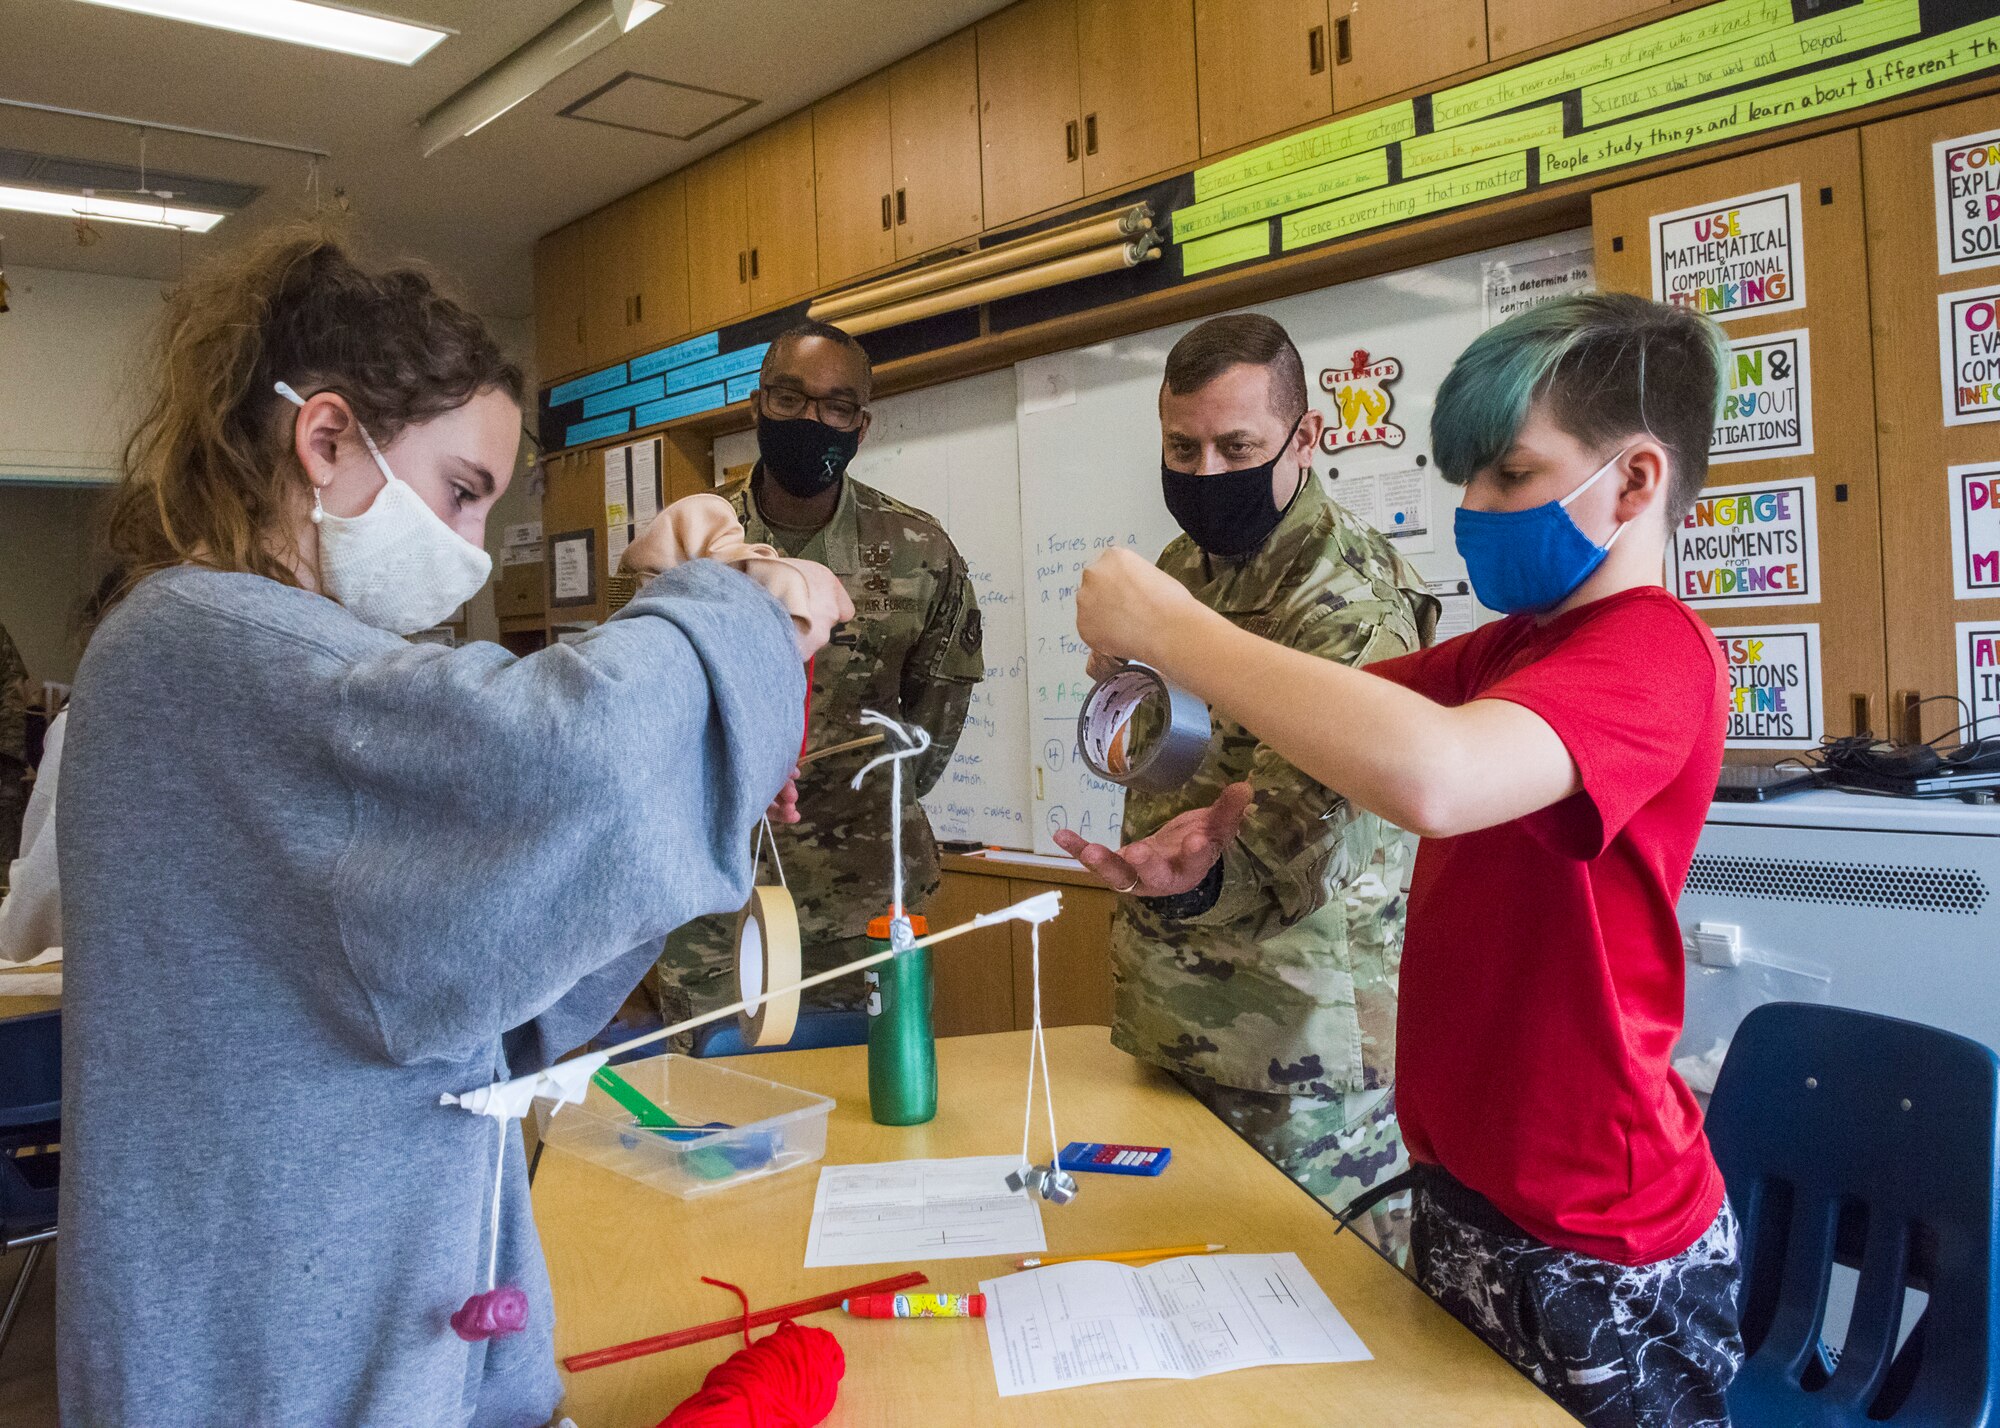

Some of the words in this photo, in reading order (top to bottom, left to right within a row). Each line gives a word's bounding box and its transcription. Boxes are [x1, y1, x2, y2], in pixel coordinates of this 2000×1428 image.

[1434, 99, 1479, 123] Science
[1486, 95, 1495, 106] is
[1499, 81, 1515, 102] the
[1521, 79, 1544, 95] never
[1637, 41, 1663, 62] people
[1669, 31, 1692, 51] who
[1591, 89, 1640, 114] Science
[1665, 74, 1688, 94] about
[1722, 60, 1744, 79] world
[1753, 48, 1777, 69] and
[1546, 150, 1589, 173] People
[1597, 135, 1643, 161] study
[1649, 127, 1704, 148] things
[1707, 105, 1738, 132] and
[1749, 100, 1795, 122] learn
[1801, 78, 1857, 107] about
[1865, 59, 1960, 90] different
[1281, 137, 1333, 168] BUNCH
[1292, 215, 1333, 241] Science
[1337, 215, 1346, 228] is
[1424, 178, 1454, 204] that
[1460, 182, 1471, 196] is
[1475, 168, 1525, 191] matter
[1965, 199, 1981, 219] &
[1694, 210, 1742, 242] USE
[1665, 227, 1787, 271] MATHEMATICAL
[1717, 256, 1726, 266] &
[1501, 285, 1516, 296] can
[1519, 273, 1569, 292] determine
[1571, 268, 1588, 280] the
[1672, 255, 1784, 292] COMPUTATIONAL
[1500, 297, 1533, 314] central
[1325, 363, 1395, 384] SCIENCE
[1767, 349, 1792, 381] &
[1758, 387, 1795, 415] OUT
[1329, 433, 1338, 446] I
[1048, 533, 1087, 554] Forces
[1093, 535, 1115, 549] are
[1127, 533, 1137, 545] a
[1682, 529, 1798, 561] ARGUMENTS
[1036, 562, 1064, 582] push
[1072, 560, 1088, 571] or
[1725, 558, 1750, 567] from
[1041, 590, 1050, 604] a
[1057, 683, 1066, 703] A
[954, 752, 982, 765] cause
[983, 806, 1011, 820] cause
[1079, 810, 1091, 836] A
